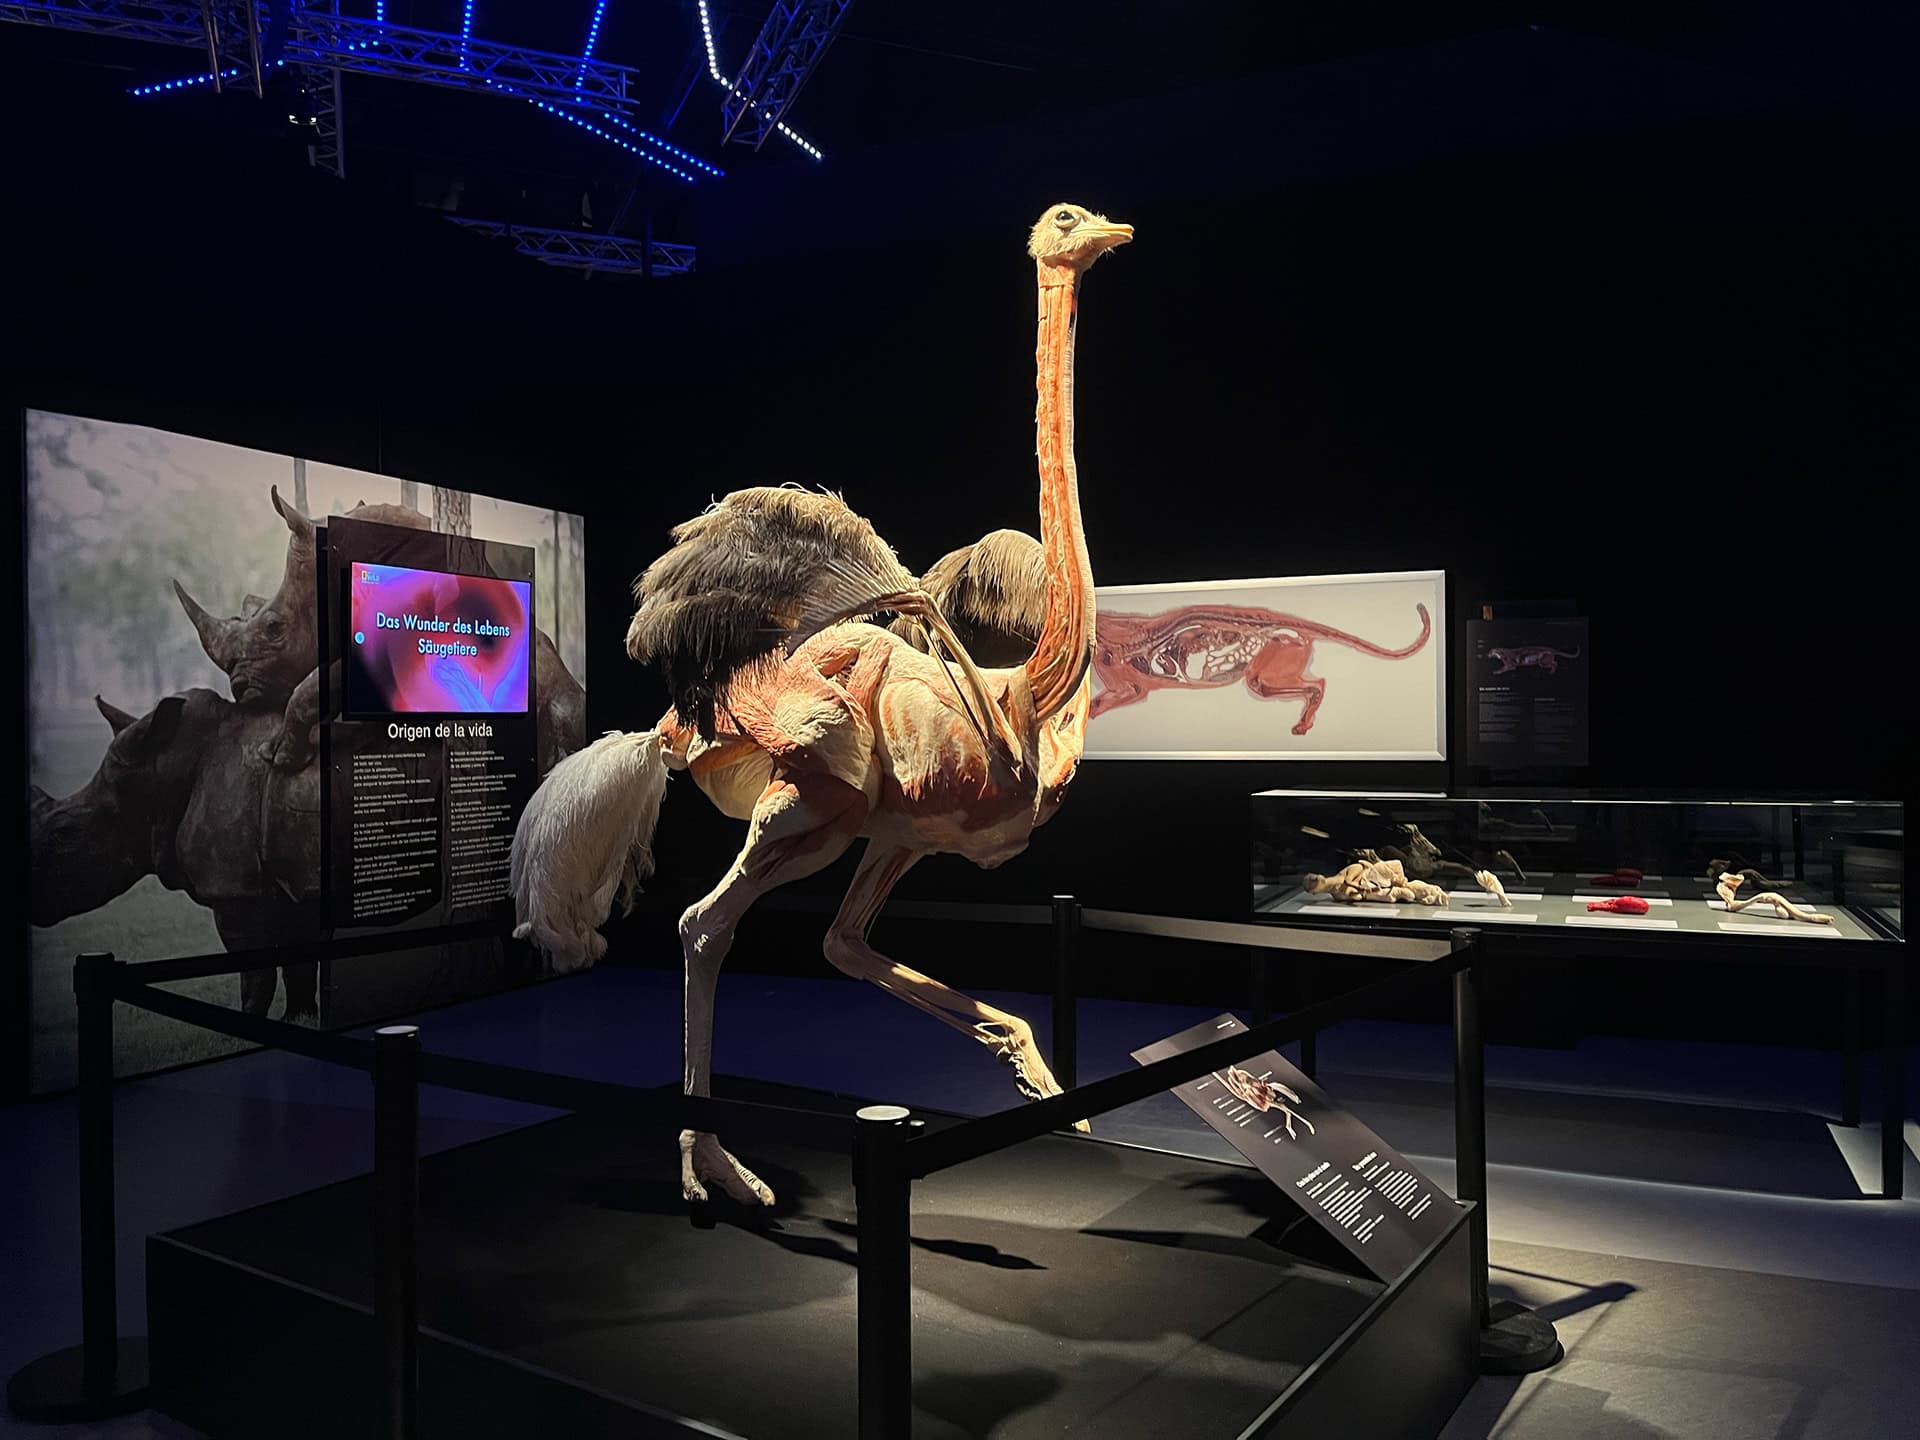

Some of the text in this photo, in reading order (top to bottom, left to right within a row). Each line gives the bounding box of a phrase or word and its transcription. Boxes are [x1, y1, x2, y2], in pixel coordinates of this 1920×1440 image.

[376, 612, 510, 637] Das Wunder des Lebens
[418, 638, 477, 660] Säugetiere
[387, 722, 493, 742] Origen de la vida
